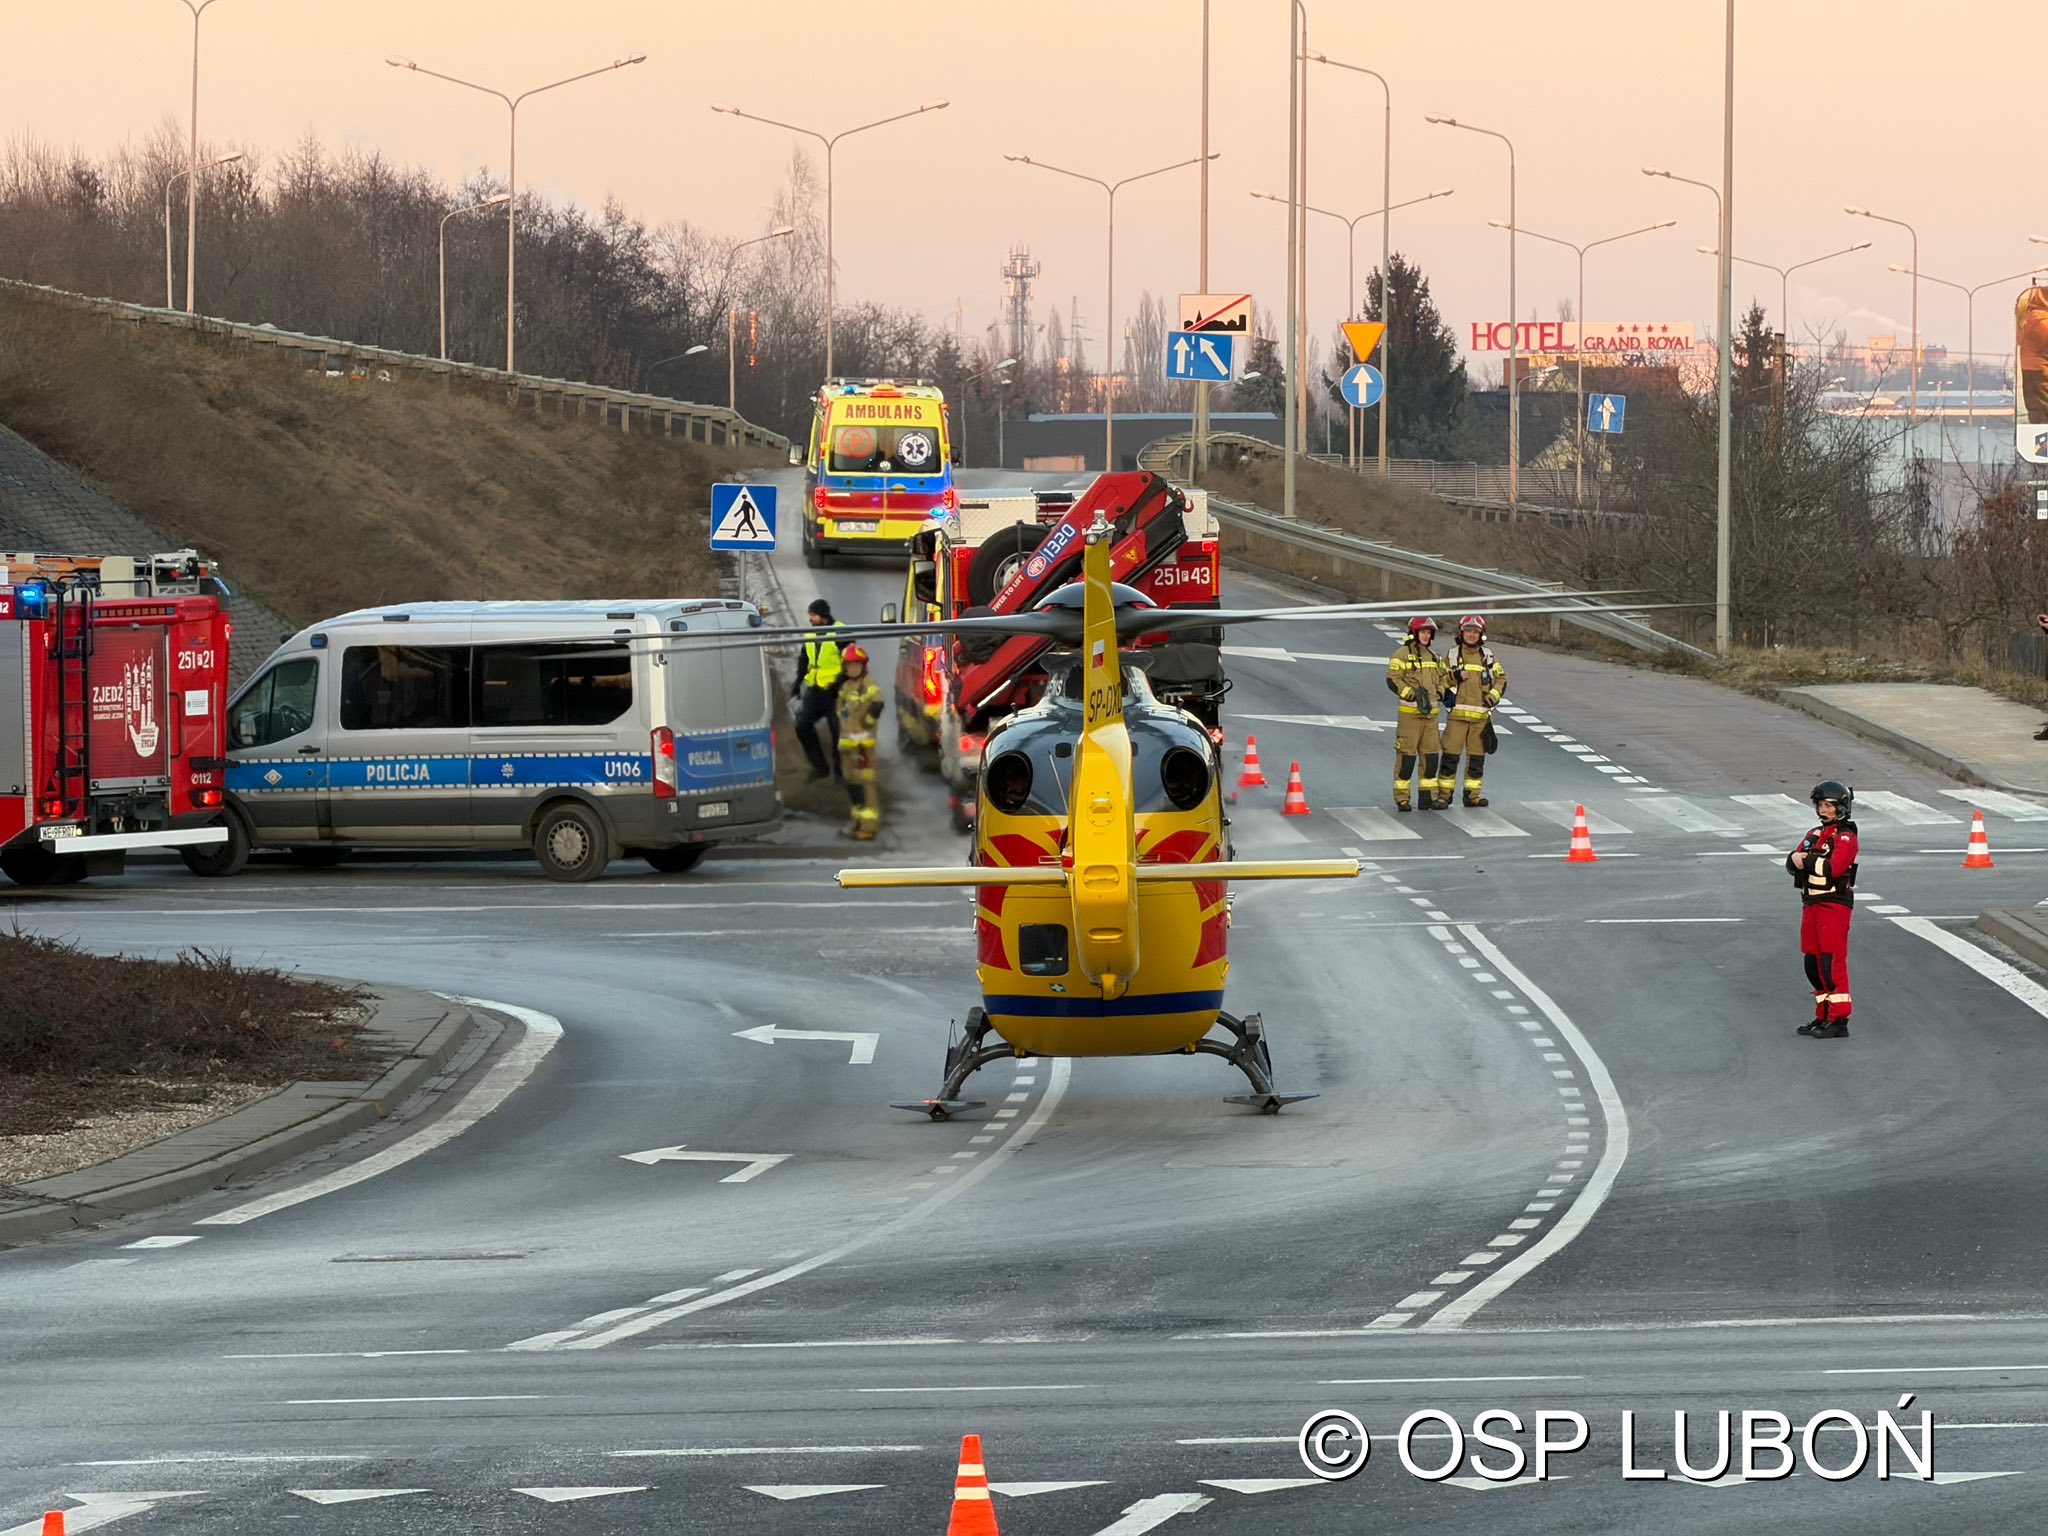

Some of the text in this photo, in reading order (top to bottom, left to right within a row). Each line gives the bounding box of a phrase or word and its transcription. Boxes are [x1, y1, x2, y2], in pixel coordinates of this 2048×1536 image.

[1471, 322, 1694, 351] HOTEL GRAND ROYAL
[845, 404, 922, 420] AMBULANS
[1043, 523, 1075, 558] 1320
[1028, 558, 1046, 576] HMF
[93, 682, 124, 703] ZJEDŹ
[367, 764, 430, 781] POLICJA
[604, 761, 640, 777] U106
